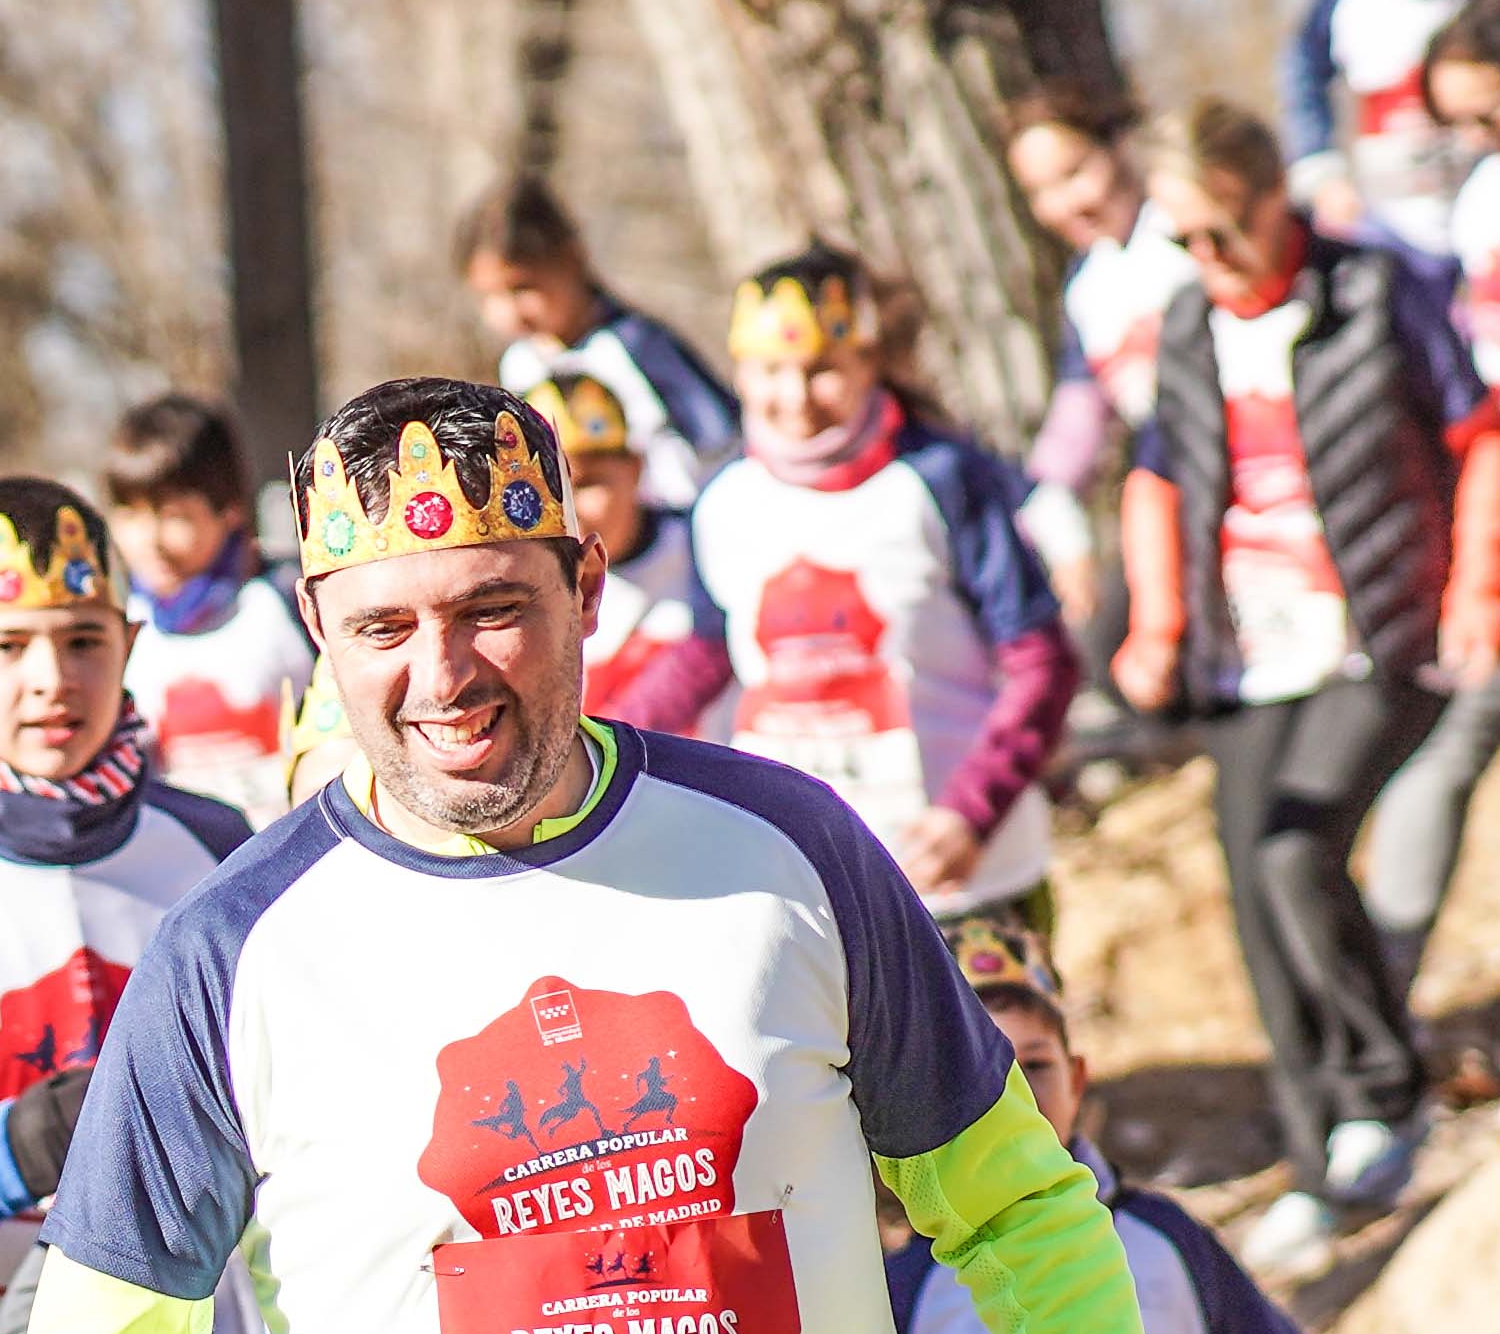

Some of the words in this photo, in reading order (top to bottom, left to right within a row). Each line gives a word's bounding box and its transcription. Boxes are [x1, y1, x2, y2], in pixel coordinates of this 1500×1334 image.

[503, 1144, 593, 1182] CARRERA
[597, 1127, 688, 1156] POPULAR
[582, 1163, 595, 1174] de
[596, 1159, 612, 1170] los
[491, 1177, 594, 1235] REYES
[604, 1148, 717, 1211] MAGOS
[650, 1198, 721, 1226] MADRID
[541, 1293, 623, 1316] CARRERA
[627, 1288, 708, 1305] POPULAR
[612, 1308, 625, 1318] de
[626, 1306, 640, 1317] los
